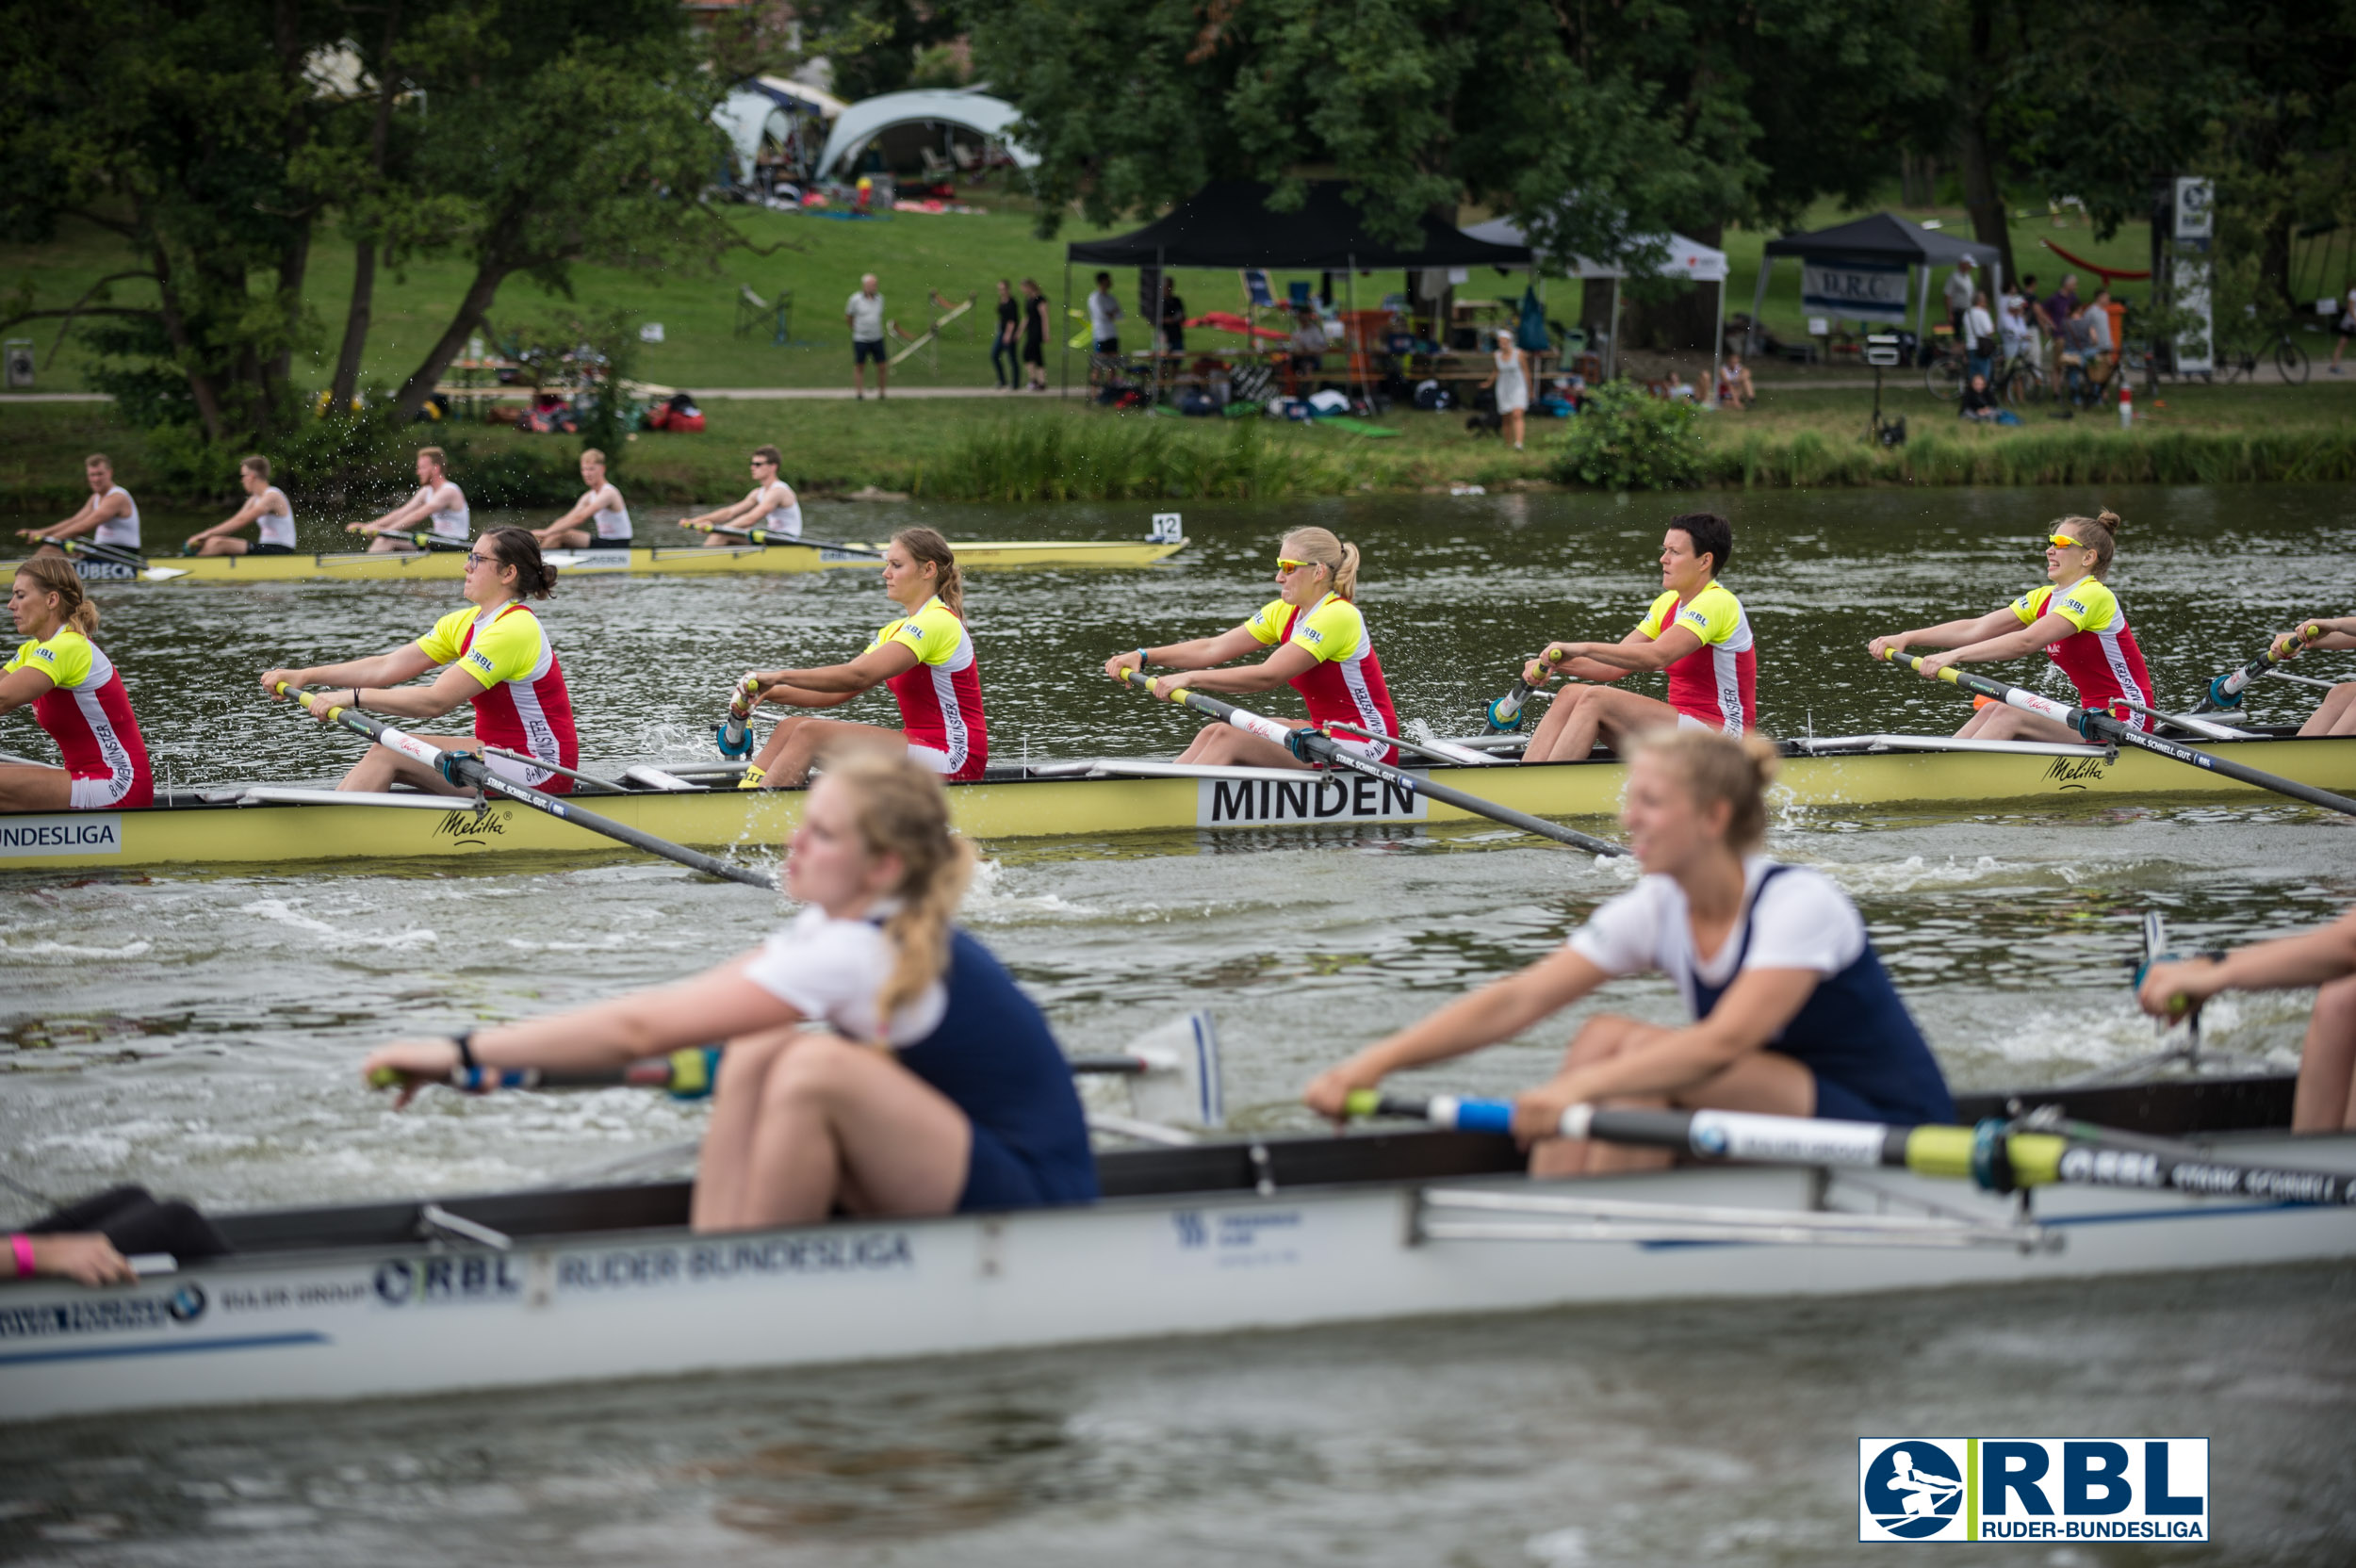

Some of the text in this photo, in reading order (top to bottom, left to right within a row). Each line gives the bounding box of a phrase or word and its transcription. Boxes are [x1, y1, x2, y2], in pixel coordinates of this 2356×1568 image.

[1158, 517, 1177, 534] 12
[77, 558, 135, 580] ÜBECK
[473, 652, 492, 672] RBL
[2147, 740, 2176, 757] SCHNELL.
[2176, 750, 2191, 761] GUT.
[2040, 755, 2104, 782] Melitta
[1212, 776, 1414, 822] MINDEN
[432, 807, 507, 838] Melitta
